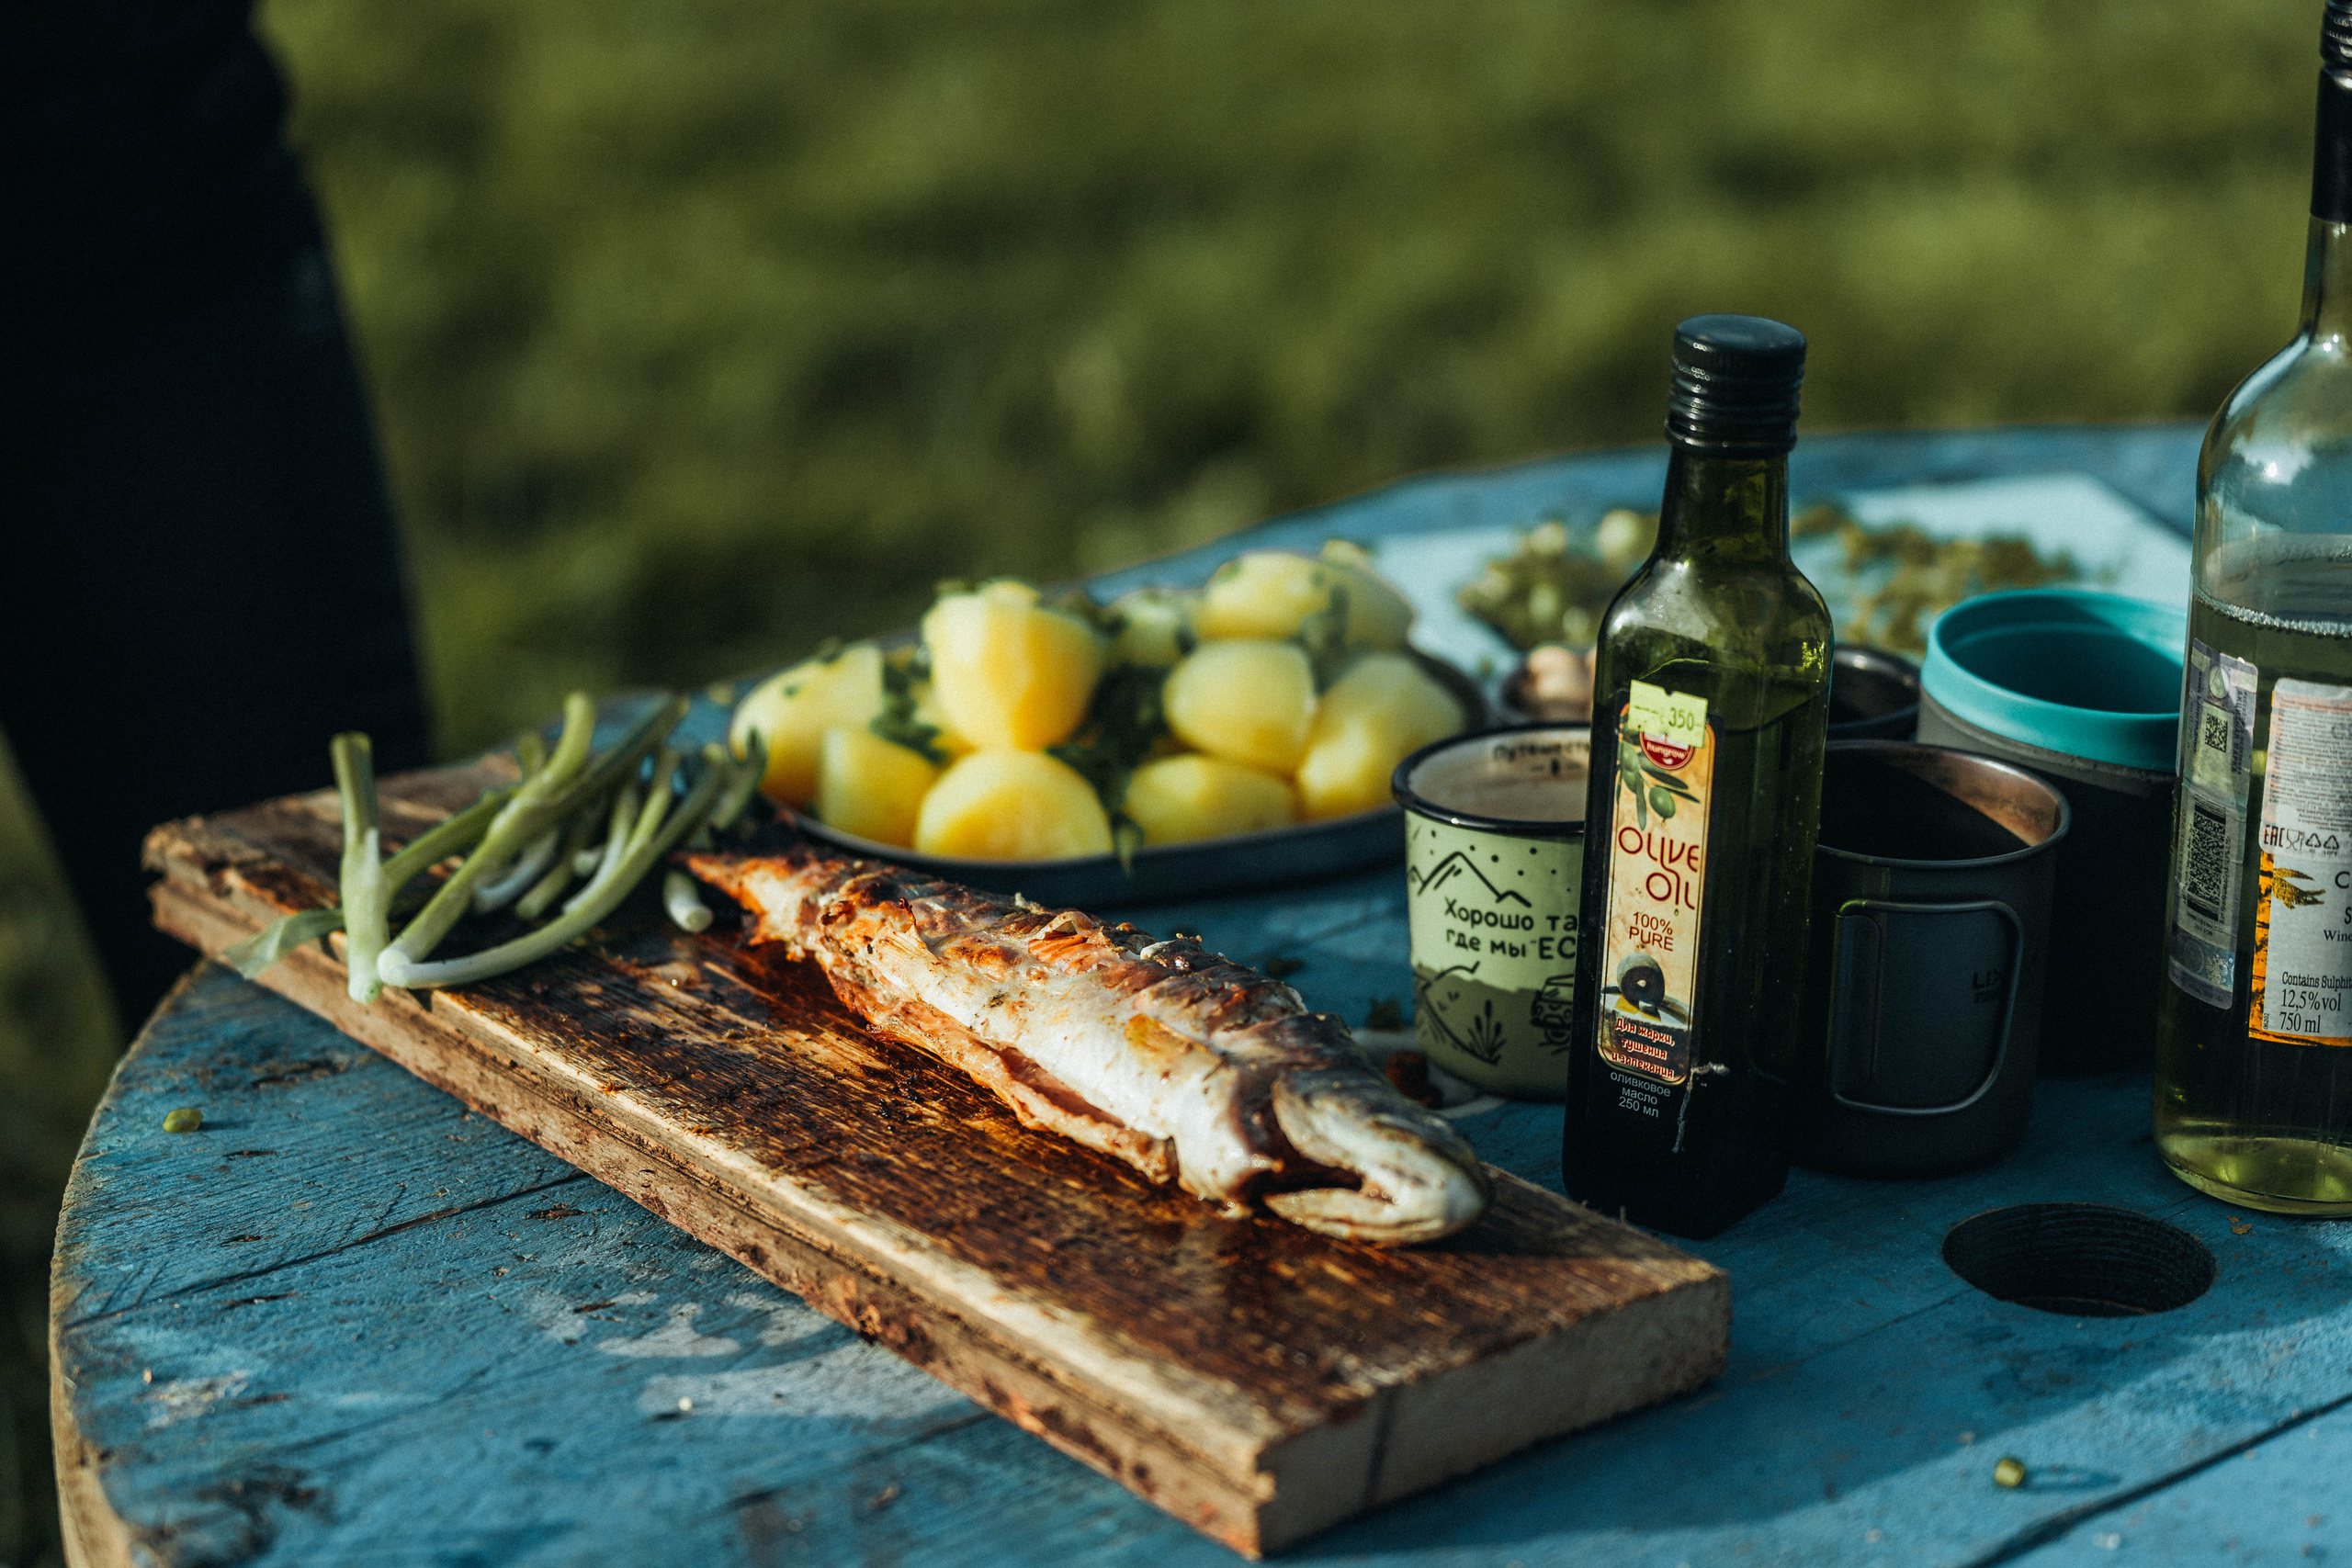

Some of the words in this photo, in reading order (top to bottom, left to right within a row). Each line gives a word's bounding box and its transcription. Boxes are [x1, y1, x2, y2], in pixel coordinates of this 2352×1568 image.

[1668, 706, 1695, 731] 350
[1646, 740, 1686, 761] hungrow
[1618, 827, 1699, 873] OLIVE
[1645, 872, 1695, 910] OIL
[1444, 897, 1534, 931] Хорошо
[1633, 911, 1673, 936] 100%
[1446, 929, 1481, 953] где
[1490, 940, 1526, 958] мы
[1629, 925, 1674, 952] PURE
[2281, 971, 2320, 988] Contains
[1615, 1018, 1636, 1034] Для
[1637, 1026, 1675, 1046] жарки,
[2279, 1011, 2301, 1032] 750
[2304, 1015, 2321, 1033] ml
[1622, 1038, 1668, 1061] тушения
[1611, 1052, 1618, 1062] и
[1620, 1055, 1675, 1079] запекания
[1610, 1071, 1671, 1098] оливковое
[1622, 1087, 1657, 1105] масло
[1618, 1096, 1640, 1111] 250
[1643, 1105, 1659, 1118] мл
